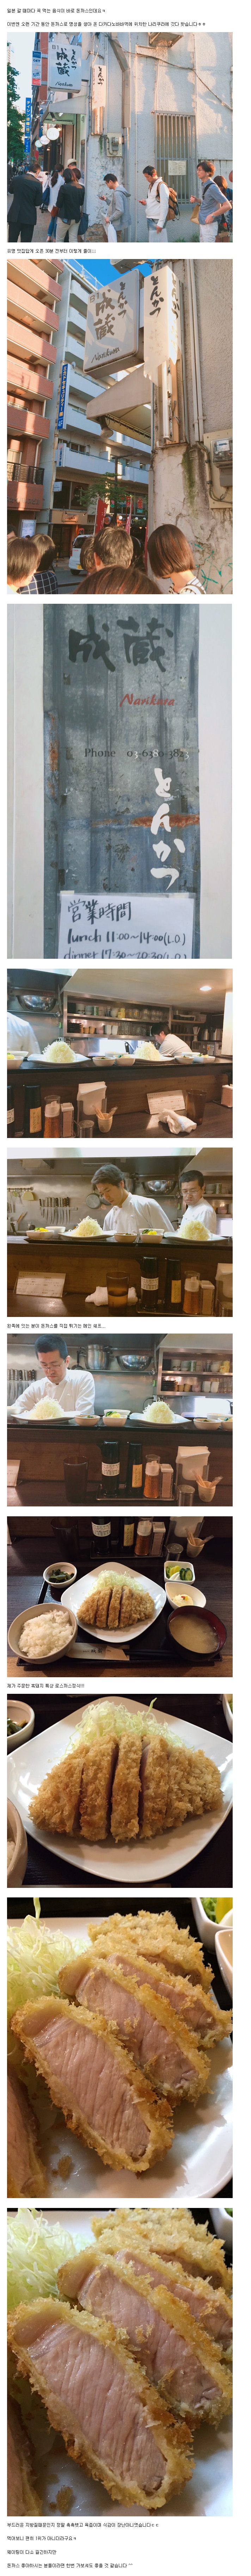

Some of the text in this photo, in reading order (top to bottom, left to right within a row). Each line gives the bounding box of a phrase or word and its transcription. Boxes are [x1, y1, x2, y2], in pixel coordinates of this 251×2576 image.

[55, 48, 70, 77] 成蔵
[90, 292, 99, 303] B1
[117, 282, 128, 319] とんかつ
[149, 276, 164, 318] とんかつ
[93, 289, 115, 340] 成蔵
[91, 347, 120, 363] Narikura
[68, 615, 173, 672] 成蔵
[119, 693, 175, 708] Narikura
[84, 748, 190, 760] Phone 03-6380-3823
[150, 767, 185, 890] とんかつ
[68, 899, 131, 925] 営業時間
[67, 929, 102, 944] lunch
[63, 947, 99, 959] dinner
